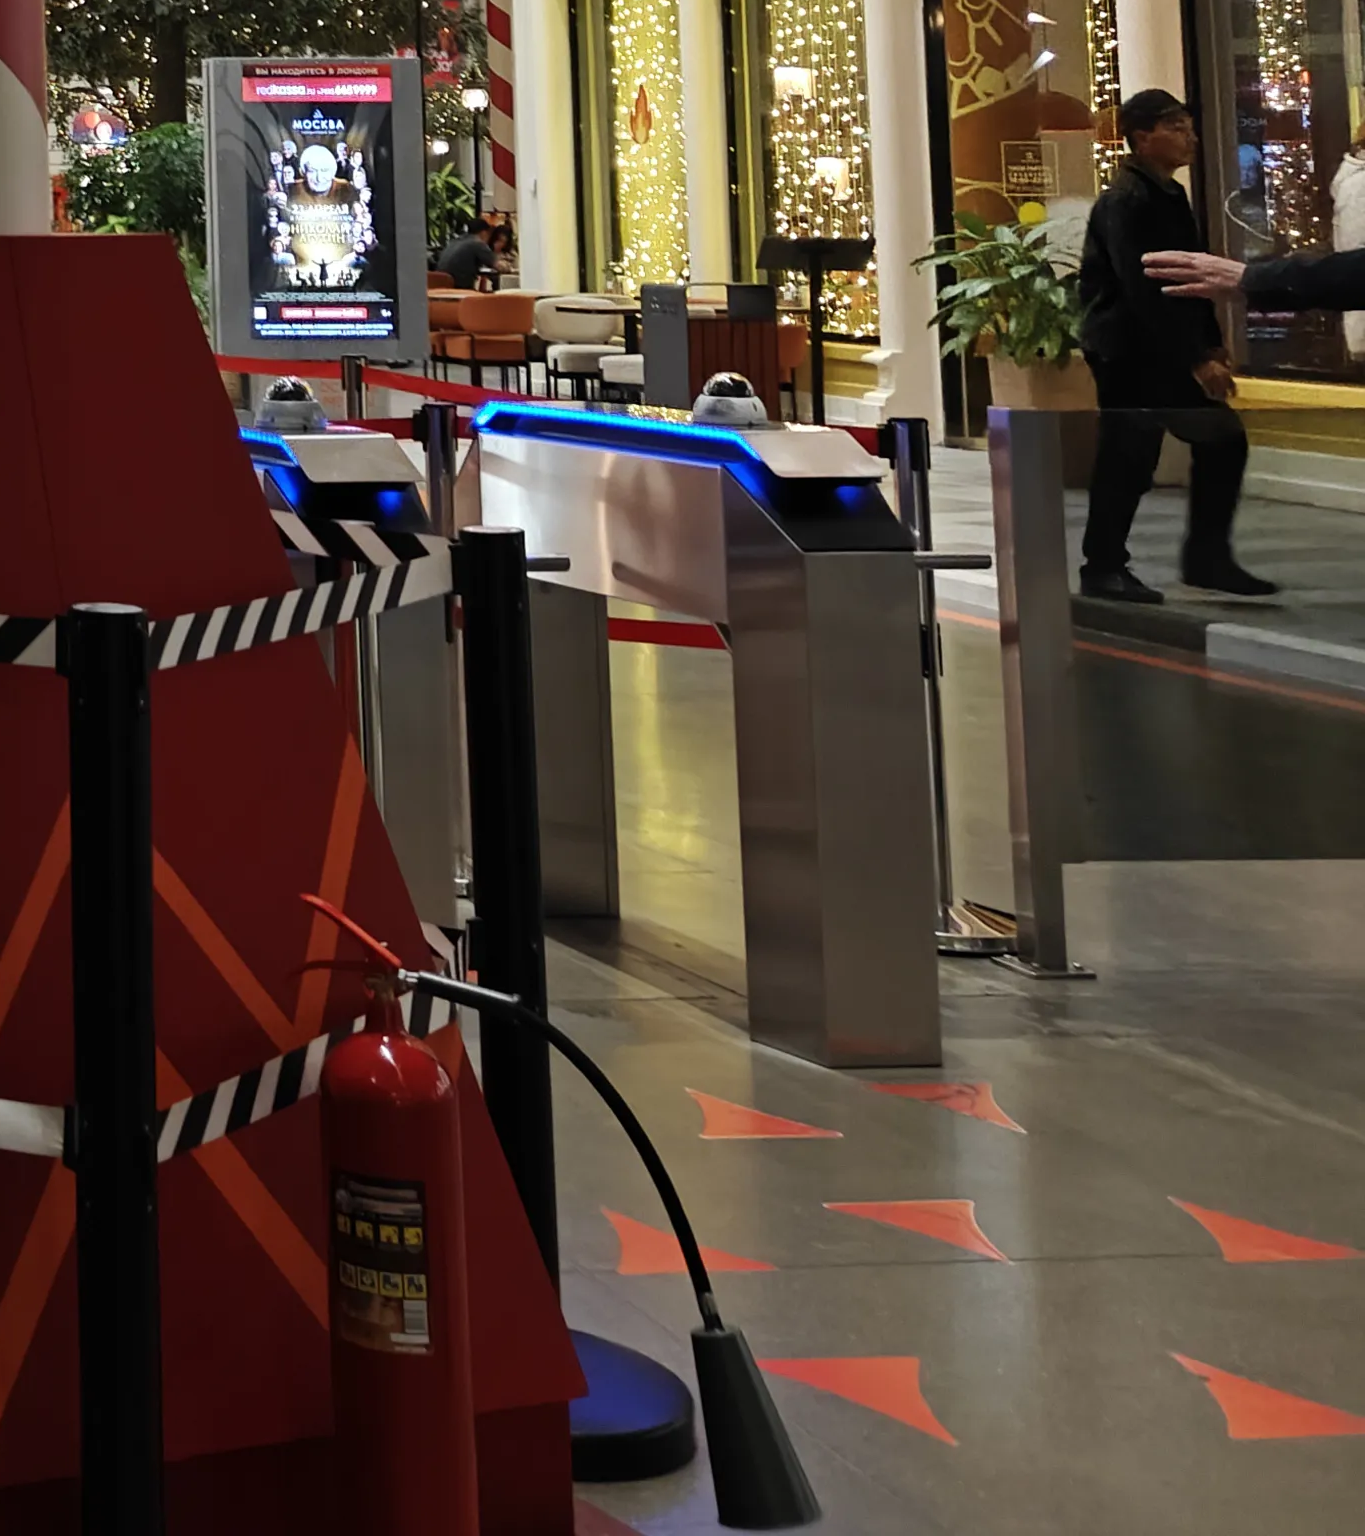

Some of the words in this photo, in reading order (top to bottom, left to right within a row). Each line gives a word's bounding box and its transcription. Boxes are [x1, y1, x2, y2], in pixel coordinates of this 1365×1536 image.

[255, 67, 269, 75] ВЫ
[270, 67, 327, 76] НАХОДИТЕСЬ
[336, 67, 379, 75] ЛОНДОНЕ
[291, 118, 345, 131] МОСКВА
